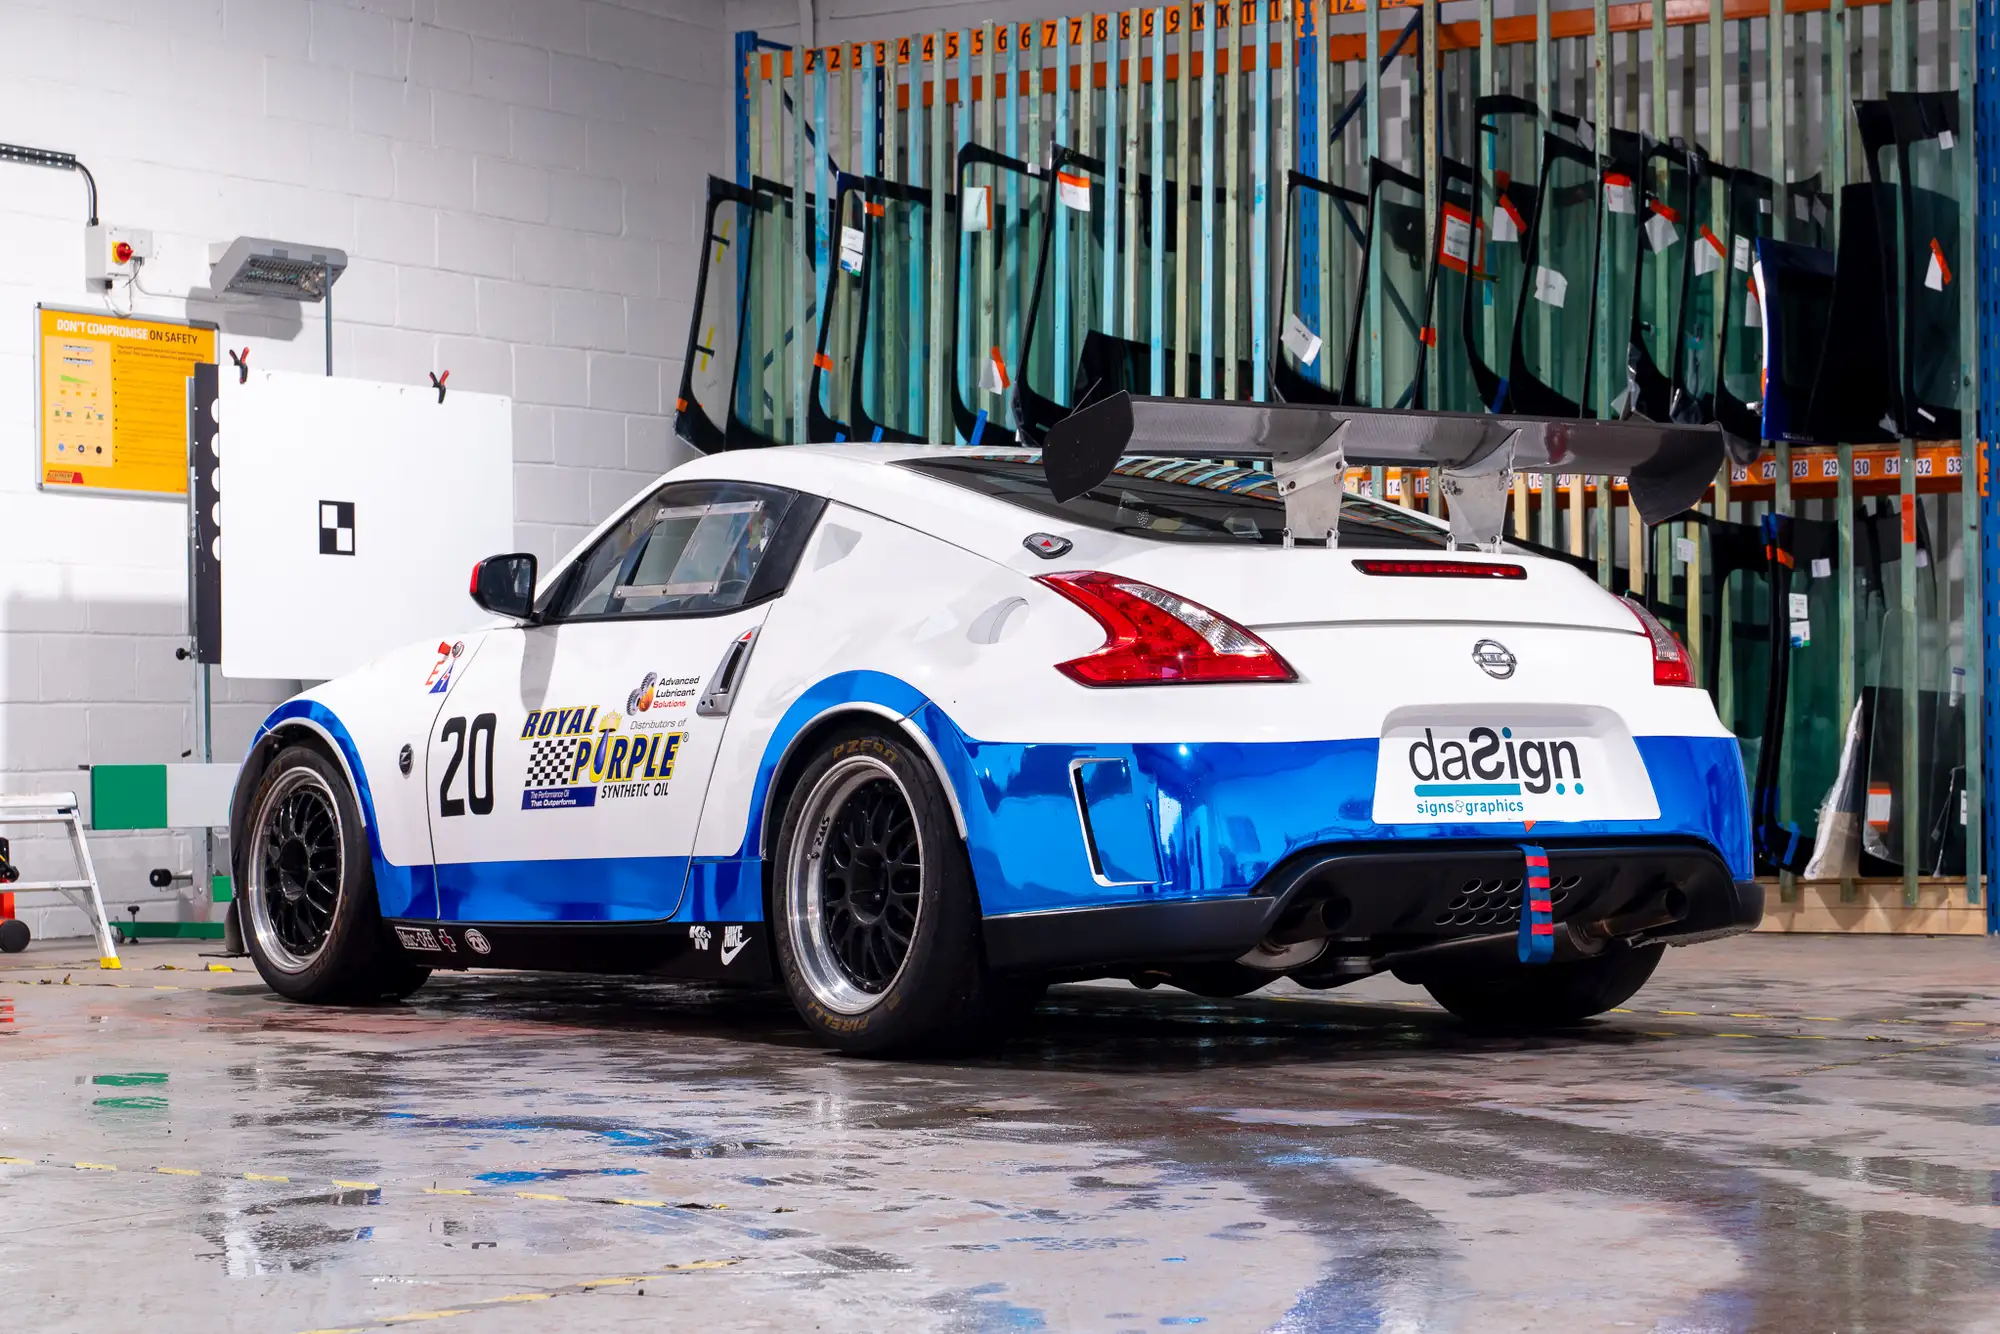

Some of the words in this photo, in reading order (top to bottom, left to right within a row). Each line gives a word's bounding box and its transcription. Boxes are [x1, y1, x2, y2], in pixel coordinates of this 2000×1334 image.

[831, 47, 840, 69] 2
[876, 43, 885, 64] 3
[899, 39, 909, 60] 4
[923, 36, 934, 59] 4
[946, 35, 958, 60] 5
[975, 30, 984, 53] 5
[998, 28, 1007, 50] 6
[1021, 27, 1030, 48] 6
[1046, 24, 1057, 46] 7
[1071, 21, 1082, 46] 7
[1097, 18, 1107, 40] 8
[1121, 15, 1130, 37] 8
[1145, 13, 1153, 35] 9
[1170, 10, 1180, 32] 9
[57, 319, 87, 333] DON'T
[87, 322, 148, 340] COMPROMISE
[149, 330, 163, 341] ON
[165, 332, 198, 345] SAFETY
[1388, 480, 1400, 495] 14
[1763, 462, 1777, 478] 27
[1794, 462, 1808, 477] 28
[1824, 460, 1839, 475] 29
[1855, 460, 1869, 475] 30
[1886, 458, 1900, 473] 31
[1917, 459, 1931, 474] 32
[1948, 458, 1962, 473] 33
[659, 675, 701, 687] Advanced
[656, 688, 696, 698] Lubricant
[653, 699, 687, 709] Solutions
[519, 705, 600, 740] ROYAL
[630, 720, 676, 730] Distributors
[678, 718, 688, 728] of
[440, 712, 497, 818] 20
[538, 790, 564, 799] Performance
[601, 783, 649, 799] SYNTHETIC
[653, 782, 669, 797] OIL
[531, 799, 542, 807] That
[543, 799, 577, 807] Outperforms
[724, 925, 743, 947] NIKE
